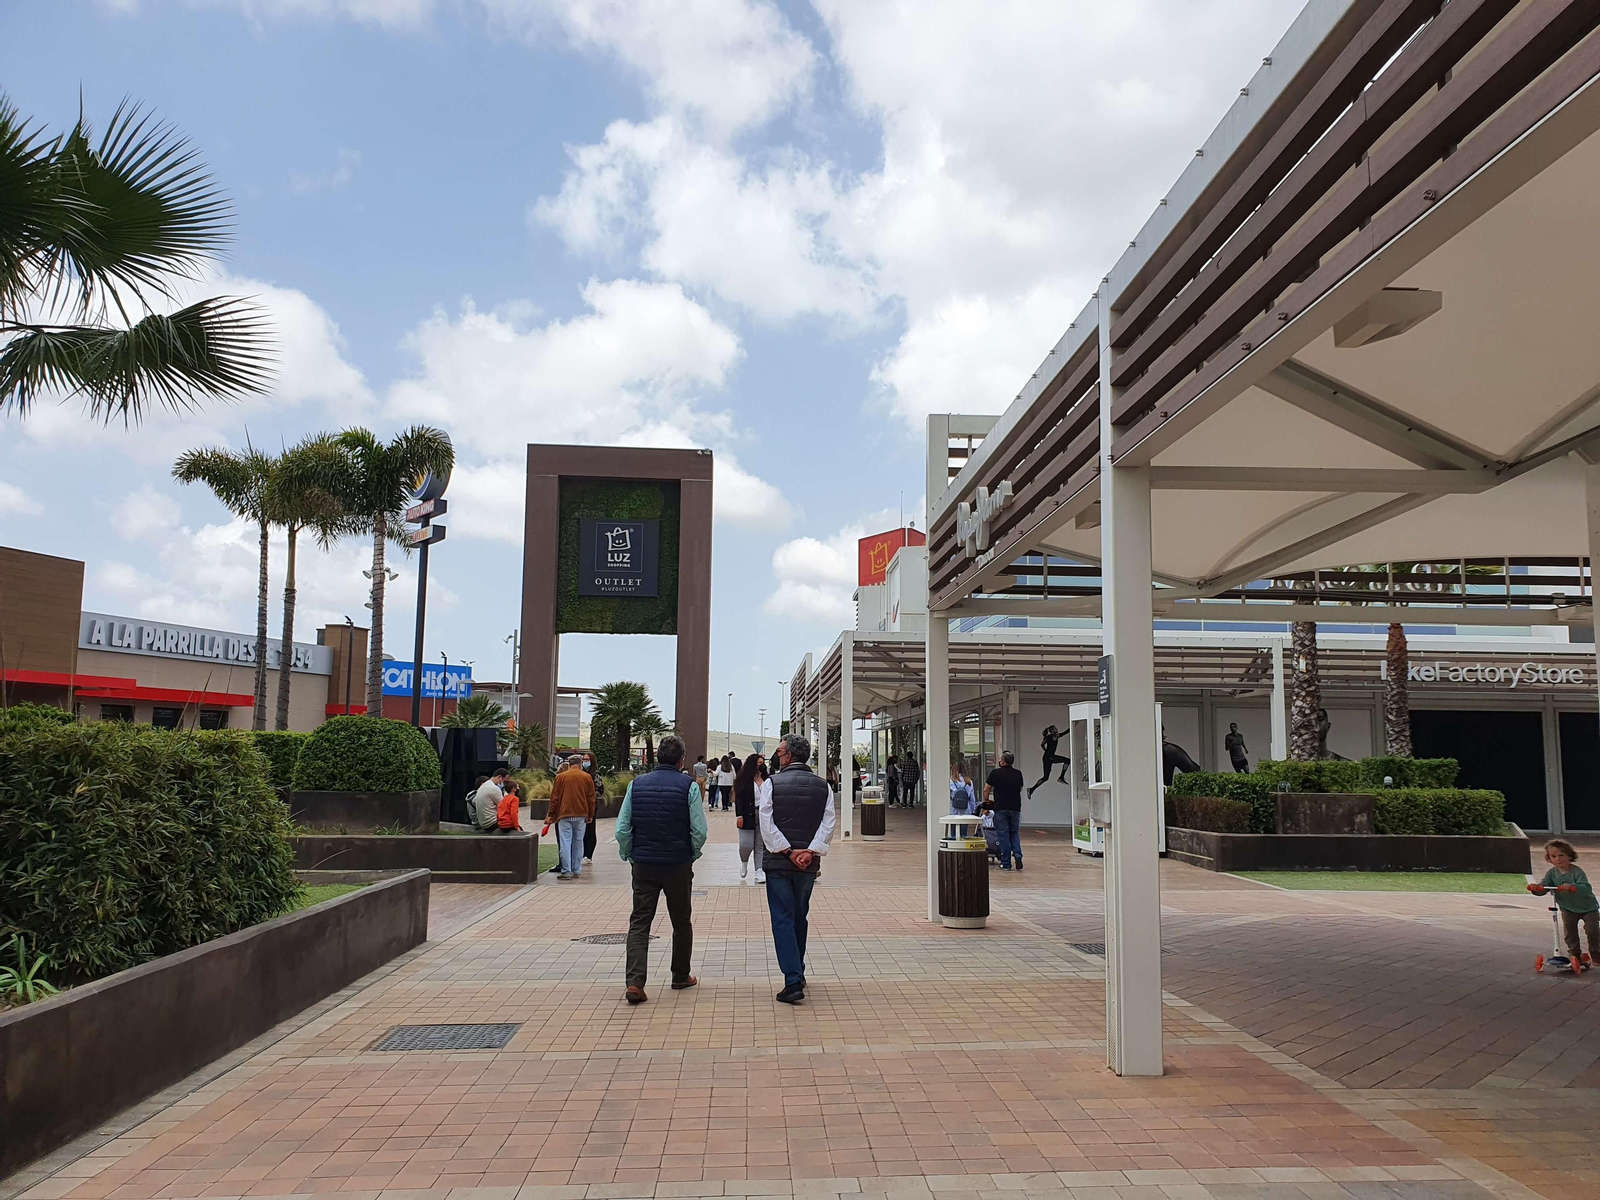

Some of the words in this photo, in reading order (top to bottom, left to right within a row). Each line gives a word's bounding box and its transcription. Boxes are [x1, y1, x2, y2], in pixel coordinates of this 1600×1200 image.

[420, 500, 435, 513] KING
[607, 553, 631, 562] LUZ
[595, 578, 642, 586] OUTLET
[91, 619, 105, 645] A
[112, 622, 136, 648] LA
[141, 626, 224, 658] PARRILLA
[229, 637, 275, 664] DESE
[382, 667, 466, 691] CATHLON
[1380, 660, 1584, 689] keFactoryStore
